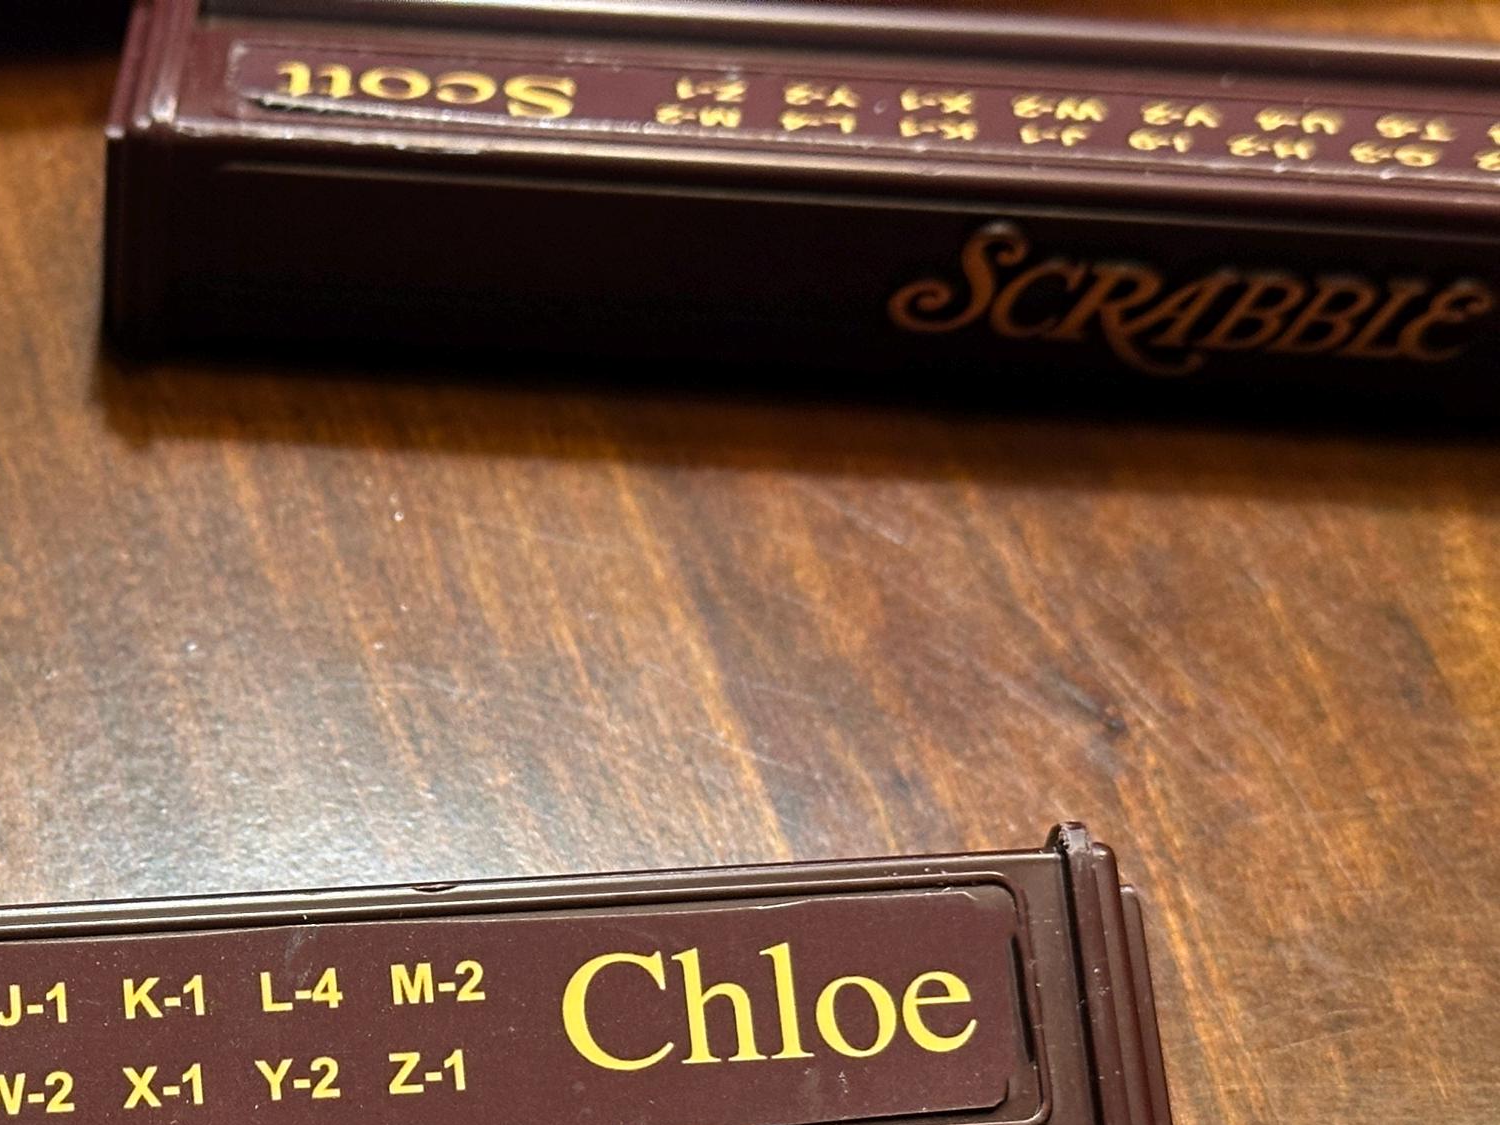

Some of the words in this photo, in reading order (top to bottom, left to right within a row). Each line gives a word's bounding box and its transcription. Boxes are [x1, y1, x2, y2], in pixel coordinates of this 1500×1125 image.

[277, 61, 576, 119] Scott
[675, 78, 747, 102] Z-1
[784, 83, 859, 109] Y-2
[900, 90, 975, 115] X-1
[655, 104, 742, 129] M-2
[1011, 95, 1108, 122] W-2
[1141, 102, 1222, 129] V-2
[779, 111, 857, 135] L-4
[899, 118, 979, 142] K-1
[1020, 124, 1090, 146] J-1
[1227, 135, 1316, 161] H-2
[888, 221, 1493, 375] SCRABBLE
[123, 976, 204, 1018] K-1
[261, 969, 342, 1012] L-4
[391, 960, 484, 1003] M-2
[562, 942, 976, 1072] Chloe
[125, 1065, 203, 1108] X-1
[257, 1057, 340, 1099] Y-2
[389, 1051, 465, 1094] Z-1
